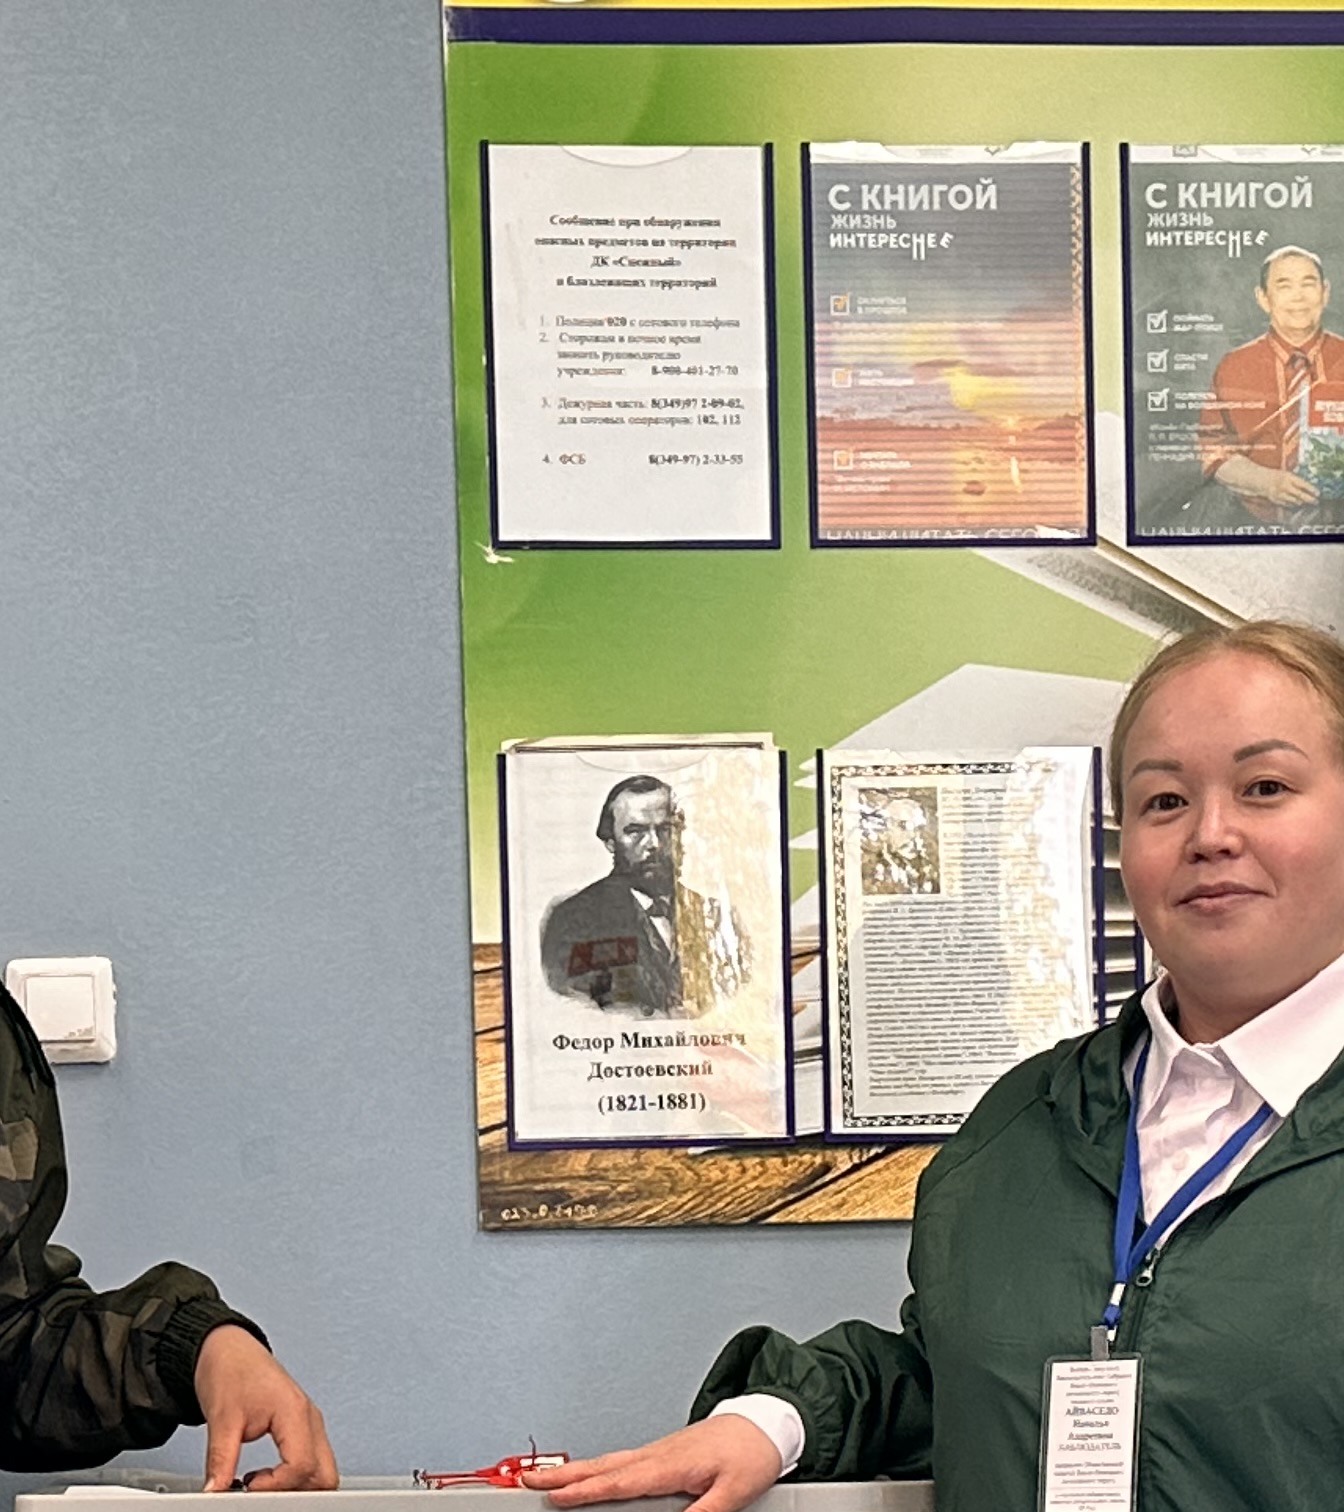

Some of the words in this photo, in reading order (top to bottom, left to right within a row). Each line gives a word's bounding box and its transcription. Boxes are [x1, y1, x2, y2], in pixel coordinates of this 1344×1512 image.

[828, 184, 851, 211] С
[860, 177, 998, 211] КНИГОЙ
[1145, 182, 1168, 209] С
[1177, 175, 1313, 209] КНИГОЙ
[830, 214, 897, 229] ЖИЗНЬ
[1147, 212, 1214, 227] ЖИЗНЬ
[829, 232, 954, 260] ИНТЕРЕСНЕЕ
[1146, 229, 1270, 258] ИНТЕРЕСНЕЕ
[559, 453, 586, 465] ФСБ
[552, 1034, 615, 1054] Федор
[620, 1031, 746, 1049] Михайлович
[586, 1060, 713, 1081] Достоевский
[597, 1092, 706, 1115] (1821-1881)
